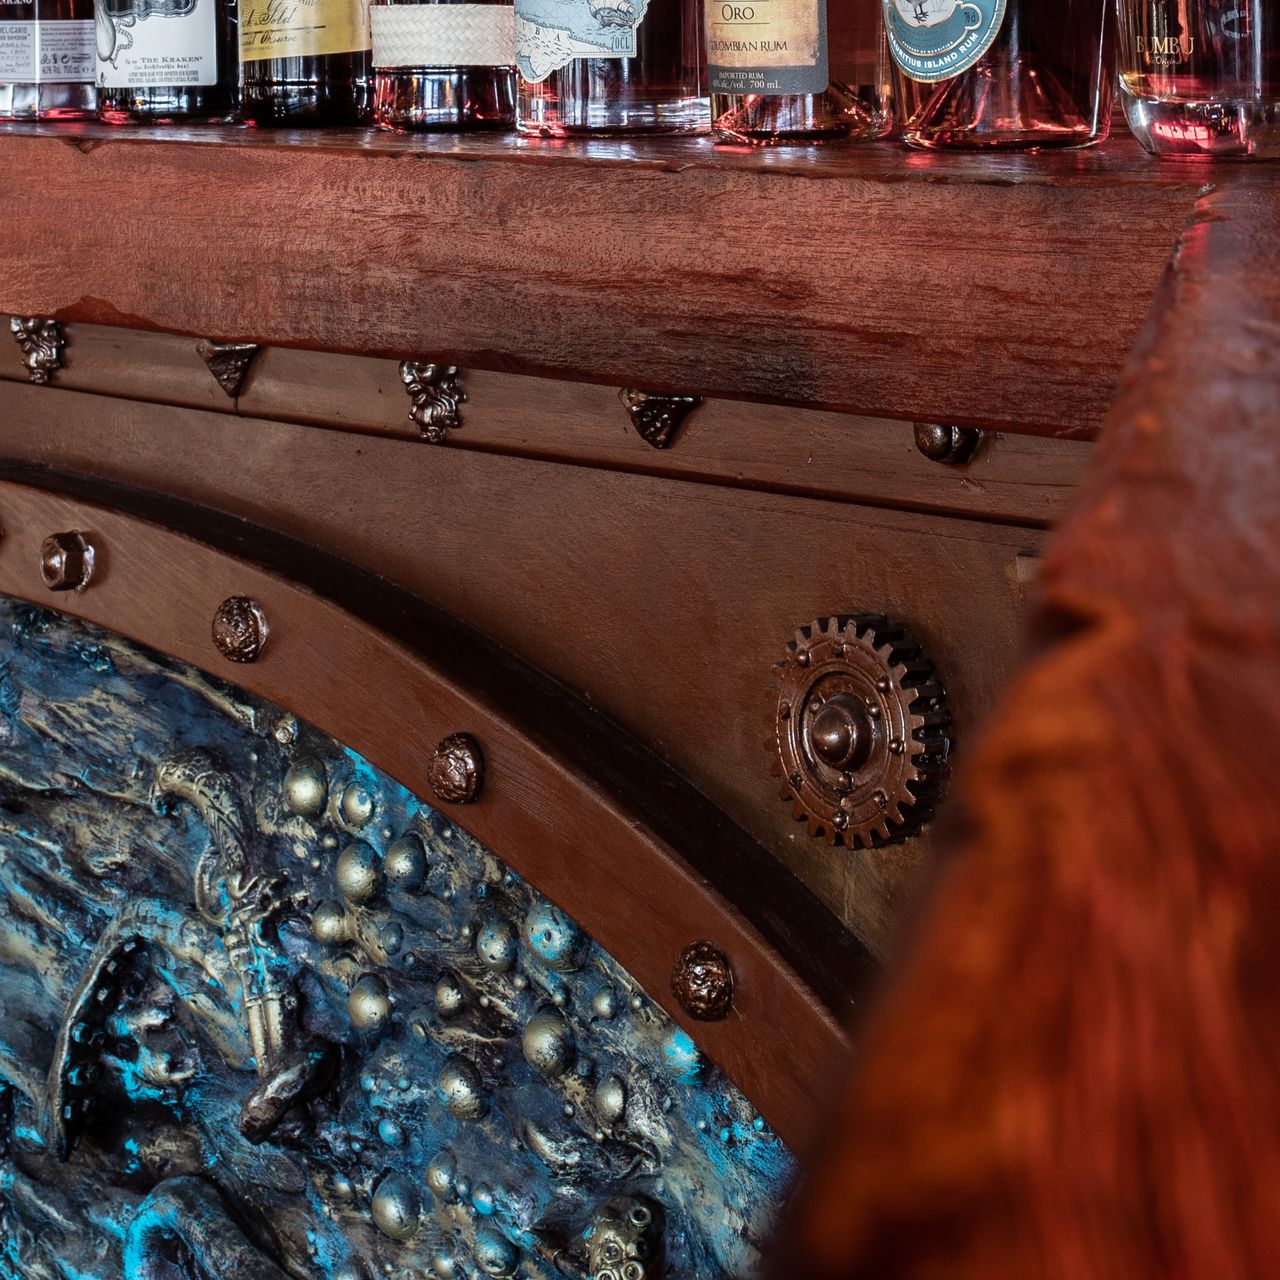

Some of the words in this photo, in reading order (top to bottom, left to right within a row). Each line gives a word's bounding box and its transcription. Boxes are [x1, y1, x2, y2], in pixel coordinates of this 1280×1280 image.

[610, 36, 630, 50] 70CL
[760, 40, 788, 52] RUM
[1136, 35, 1195, 55] BUMBU
[889, 31, 922, 68] MAURITIUS
[924, 51, 958, 69] ISLAND
[960, 32, 979, 53] RUM
[748, 72, 764, 80] RUM
[749, 80, 765, 89] 700
